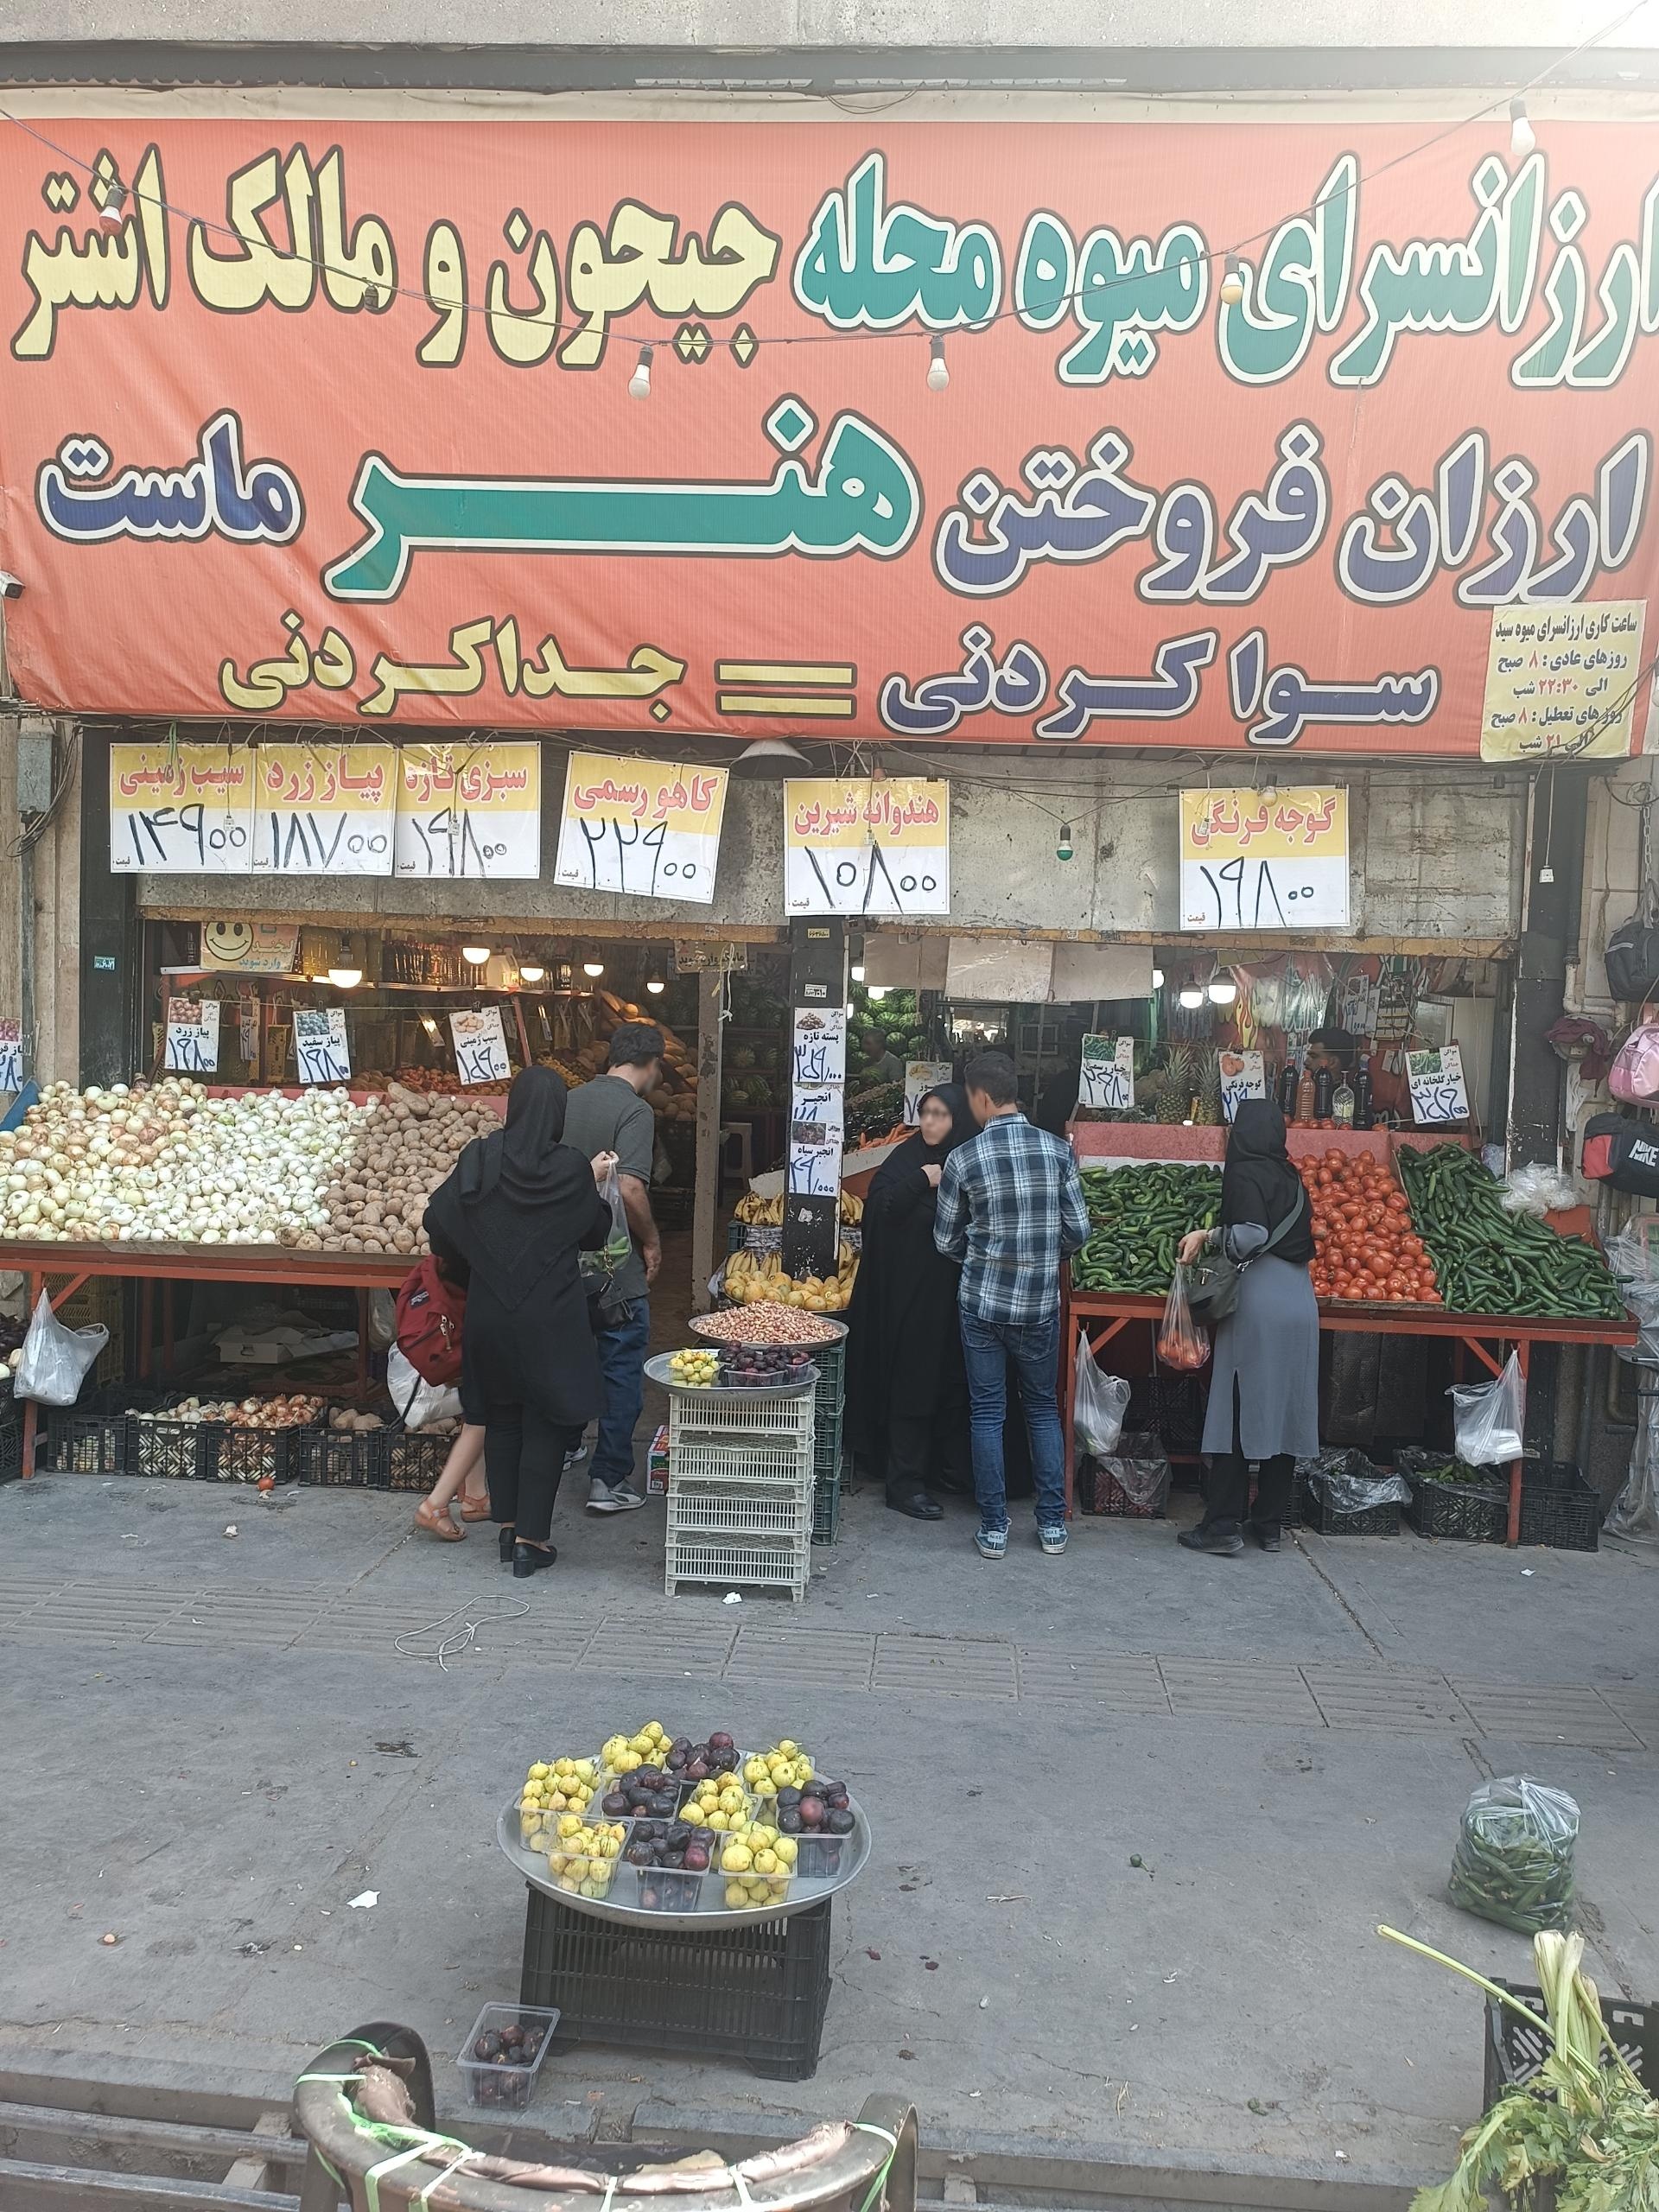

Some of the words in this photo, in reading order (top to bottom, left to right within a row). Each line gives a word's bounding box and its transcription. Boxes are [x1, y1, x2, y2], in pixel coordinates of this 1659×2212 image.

[187, 142, 397, 314] مالک
[794, 150, 1002, 333] محله
[11, 142, 170, 360] اشتر
[418, 219, 467, 368] و
[486, 199, 782, 370] جیحون
[1013, 210, 1210, 386] میوه
[36, 409, 305, 545] ماست
[322, 393, 923, 602] هنر
[935, 417, 1332, 607] فروختن
[1338, 428, 1654, 607] ارزان
[1496, 622, 1514, 642] سید
[1516, 623, 1535, 643] میوه
[1585, 613, 1611, 640] کاری
[1611, 612, 1637, 634] ساعت
[1497, 656, 1523, 673] صبح
[1529, 650, 1538, 669] ۸
[879, 622, 1220, 744] کردنی
[1513, 680, 1535, 698] شب
[1538, 678, 1578, 696] ۲۲:۳۰
[1586, 677, 1608, 696] الی
[1491, 713, 1516, 728] صبح
[1518, 707, 1528, 725] ۸
[1519, 735, 1542, 752] شب
[119, 753, 187, 797] زمینی
[190, 764, 245, 795] سیب
[266, 760, 316, 802] زرد
[318, 753, 384, 804] پیاز
[404, 754, 454, 802] تازه
[460, 760, 528, 802] سبزی
[573, 778, 650, 817] رسمی
[652, 772, 719, 819] کاهو
[793, 791, 858, 836] شیرین
[862, 791, 940, 836] هندوانه
[1191, 798, 1270, 847] فرنگی
[1273, 796, 1338, 845] گوجه
[127, 803, 247, 867] ۱۴۹۰۰
[270, 810, 388, 869] ۱۸۷۰۰
[411, 806, 507, 878] ۱۹۸۰۰
[579, 817, 696, 896] ۲۲۹۰۰
[562, 868, 579, 879] قیمت
[804, 840, 938, 915] ۱۰۸۰۰
[791, 897, 810, 909] قیمت
[1199, 855, 1314, 929] ۱۹۸۰۰
[1187, 912, 1205, 925] قیمت
[175, 1027, 192, 1038] زرد
[195, 1027, 209, 1039] پیاز
[302, 1037, 323, 1048] سفید
[326, 1035, 341, 1048] پیاز
[460, 1036, 481, 1048] زمینی
[482, 1034, 498, 1045] سیب
[804, 1032, 820, 1043] تازه
[821, 1033, 839, 1045] پسته
[918, 1082, 934, 1092] وز
[1225, 1078, 1244, 1091] فرنگی
[1245, 1078, 1262, 1090] گوجه
[1446, 1071, 1462, 1086] خیار
[800, 1091, 831, 1106] انجیر
[798, 1145, 814, 1157] سیاه
[814, 1147, 834, 1159] انجیر
[1628, 1139, 1659, 1167] NIKE
